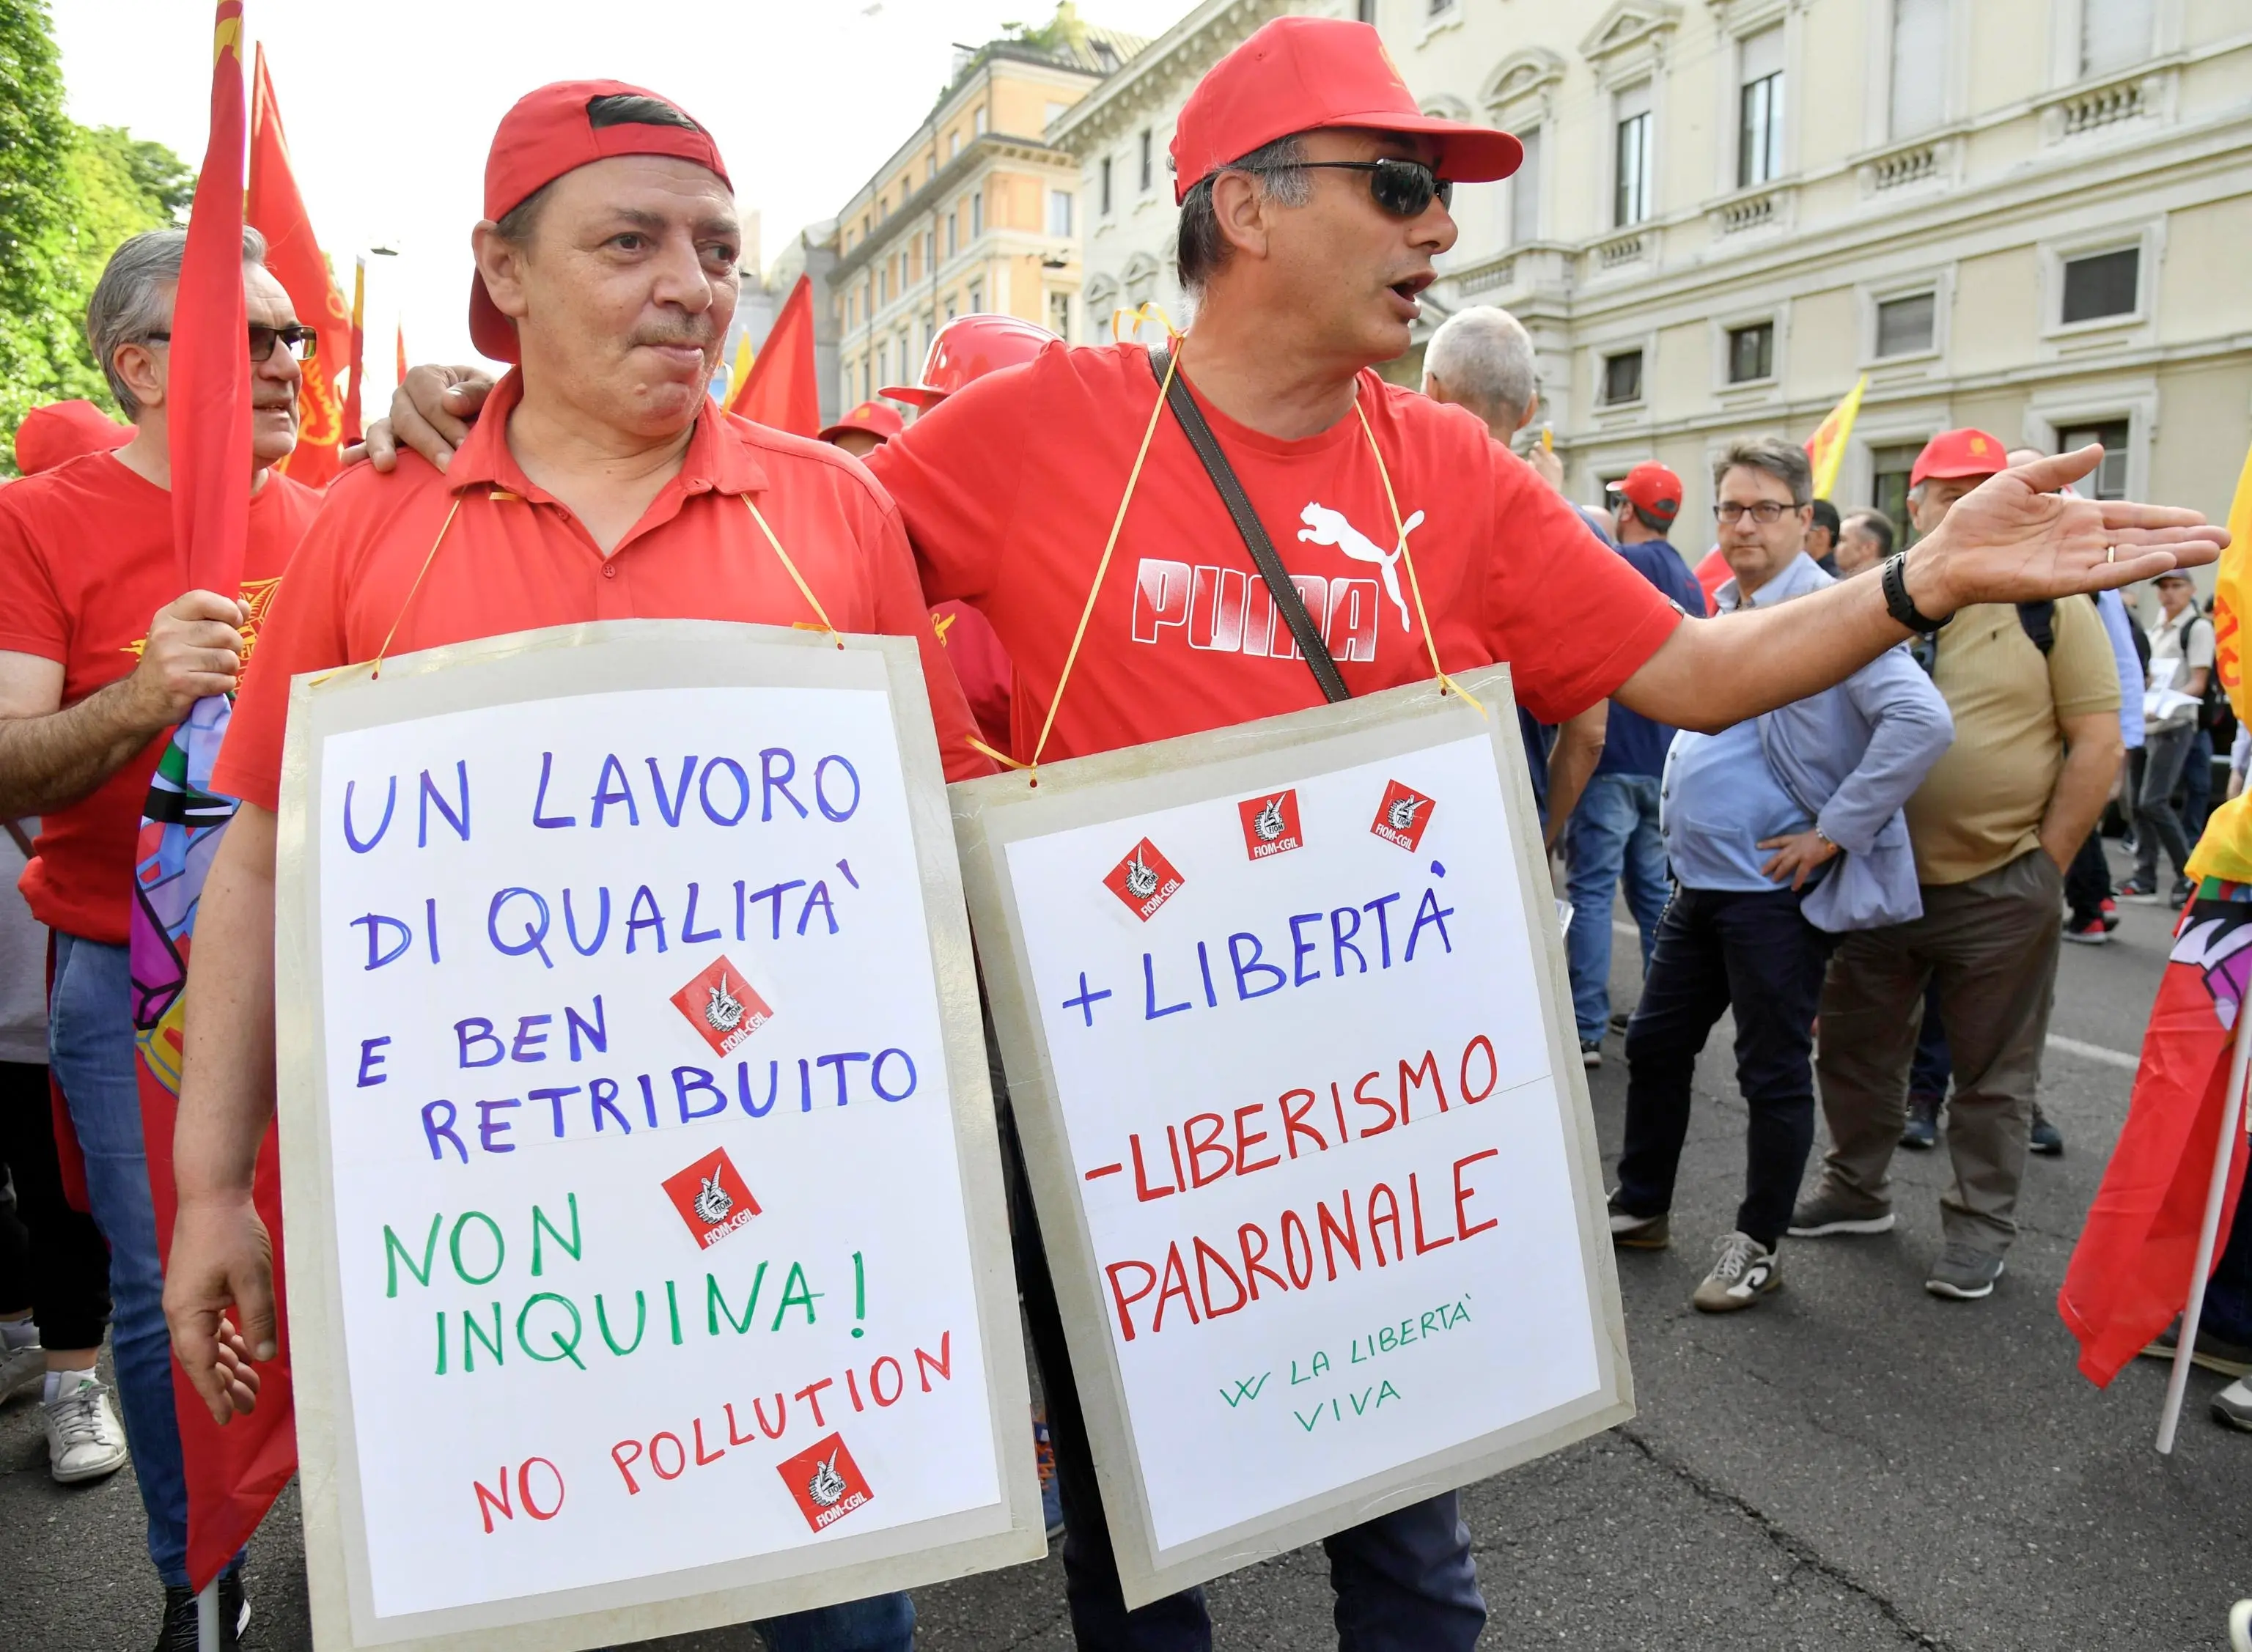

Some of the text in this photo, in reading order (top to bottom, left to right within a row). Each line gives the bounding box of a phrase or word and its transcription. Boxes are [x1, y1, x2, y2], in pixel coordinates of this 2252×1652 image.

[1132, 558, 1380, 662] PUMA
[345, 748, 859, 853] UN LAVORO
[1268, 824, 1284, 833] FIOM
[1375, 822, 1413, 850] FIOM-CGIL
[1397, 816, 1410, 827] FIOM
[1254, 836, 1298, 858] FIOM-CGIL
[1140, 878, 1180, 918] FIOM-CGIL
[1144, 874, 1158, 889] FIOM
[350, 899, 440, 970] DI
[726, 1006, 743, 1021] FIOM
[1063, 973, 1112, 1027] +
[357, 995, 607, 1088] E BEN
[720, 1011, 769, 1053] FIOM-CGIL
[422, 1049, 916, 1164] RETRIBUITO
[704, 1208, 756, 1245] FIOM-CGIL
[714, 1200, 732, 1213] FIOM
[384, 1193, 581, 1297] NON
[1105, 1149, 1498, 1341] PADRONALE
[1291, 1351, 1329, 1386] LA
[1294, 1379, 1401, 1432] VIVA
[474, 1332, 950, 1533] NO POLLUTION
[815, 1491, 867, 1527] FIOM-CGIL
[828, 1483, 845, 1496] FIOM
